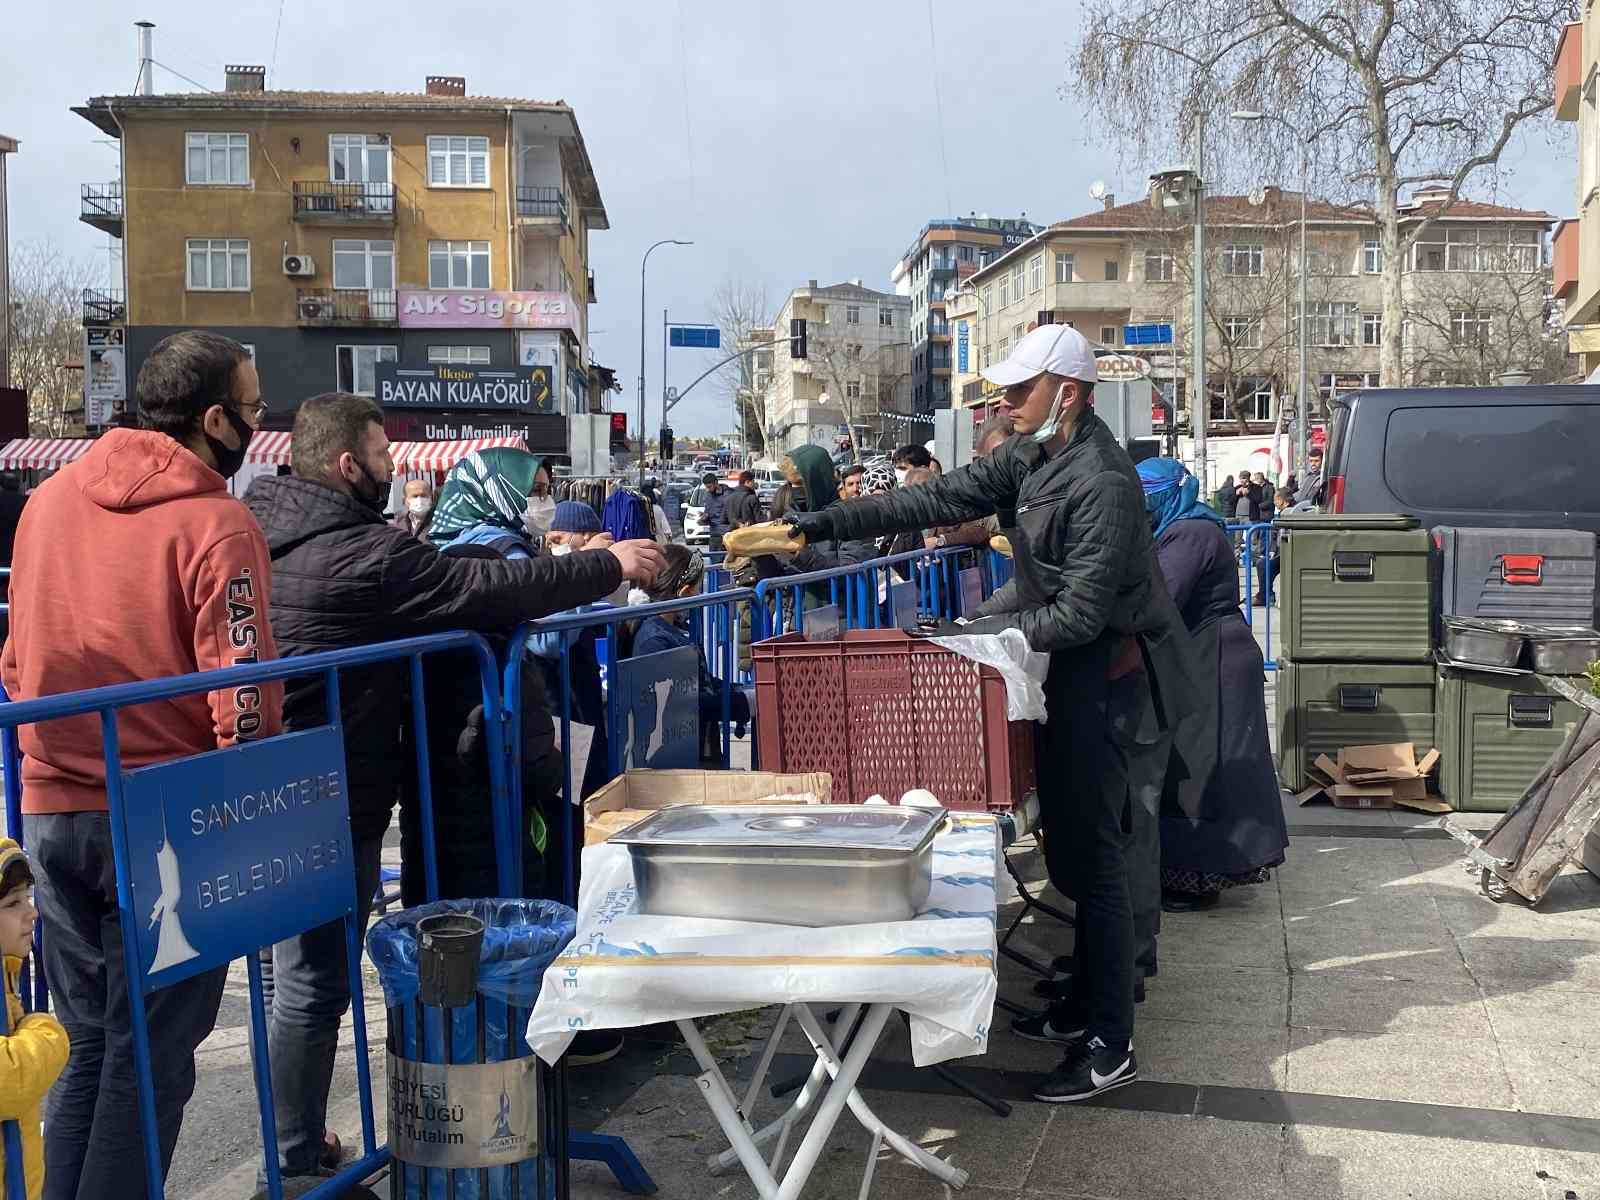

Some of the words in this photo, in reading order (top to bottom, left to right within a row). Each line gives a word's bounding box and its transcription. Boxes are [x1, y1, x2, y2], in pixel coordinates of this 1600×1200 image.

[404, 295, 449, 316] AK
[458, 294, 568, 319] Sigorta
[382, 380, 441, 402] BAYAN
[448, 379, 531, 405] KUAFÖRÜ
[425, 424, 457, 441] Unlu
[461, 424, 529, 441] Mamülleri
[233, 686, 262, 744] CO
